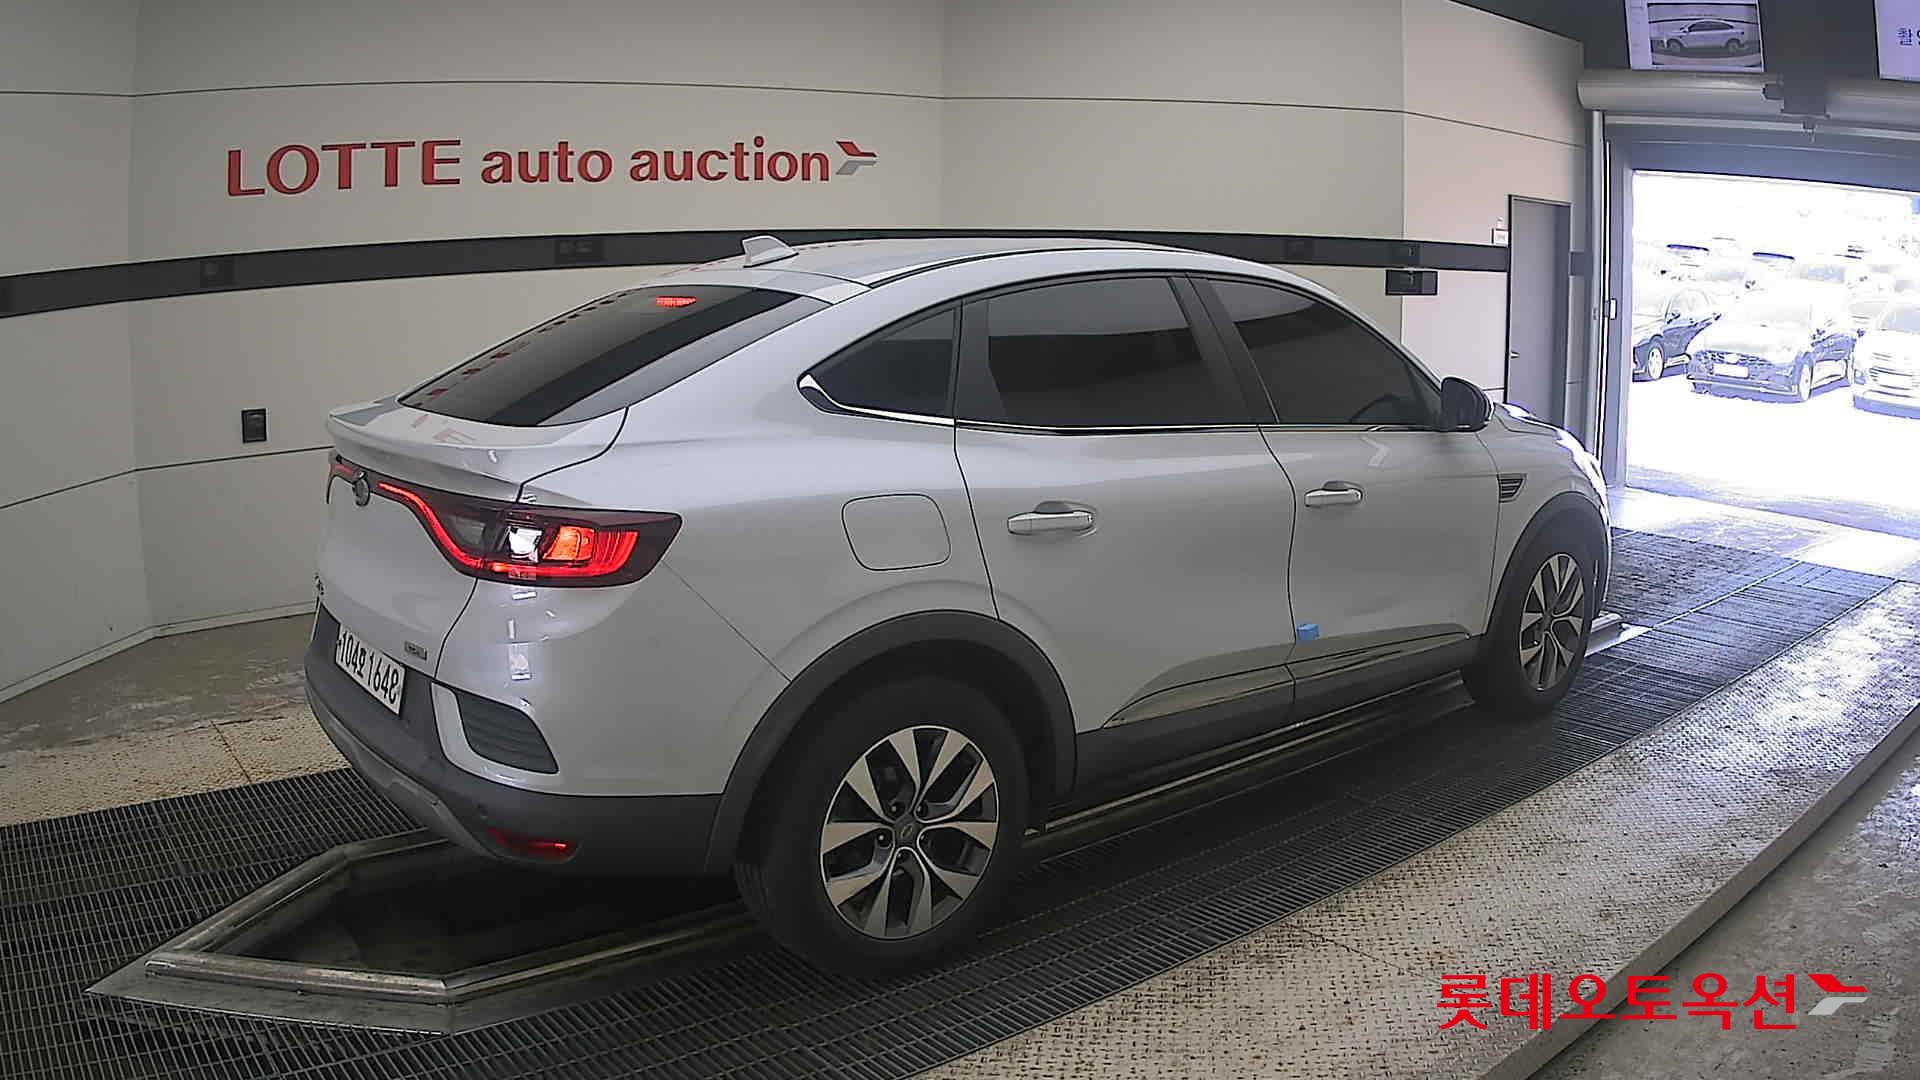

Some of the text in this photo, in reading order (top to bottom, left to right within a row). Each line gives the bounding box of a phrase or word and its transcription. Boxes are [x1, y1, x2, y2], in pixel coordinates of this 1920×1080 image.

[227, 135, 830, 197] LOTTE auto auction
[367, 649, 400, 705] 1648
